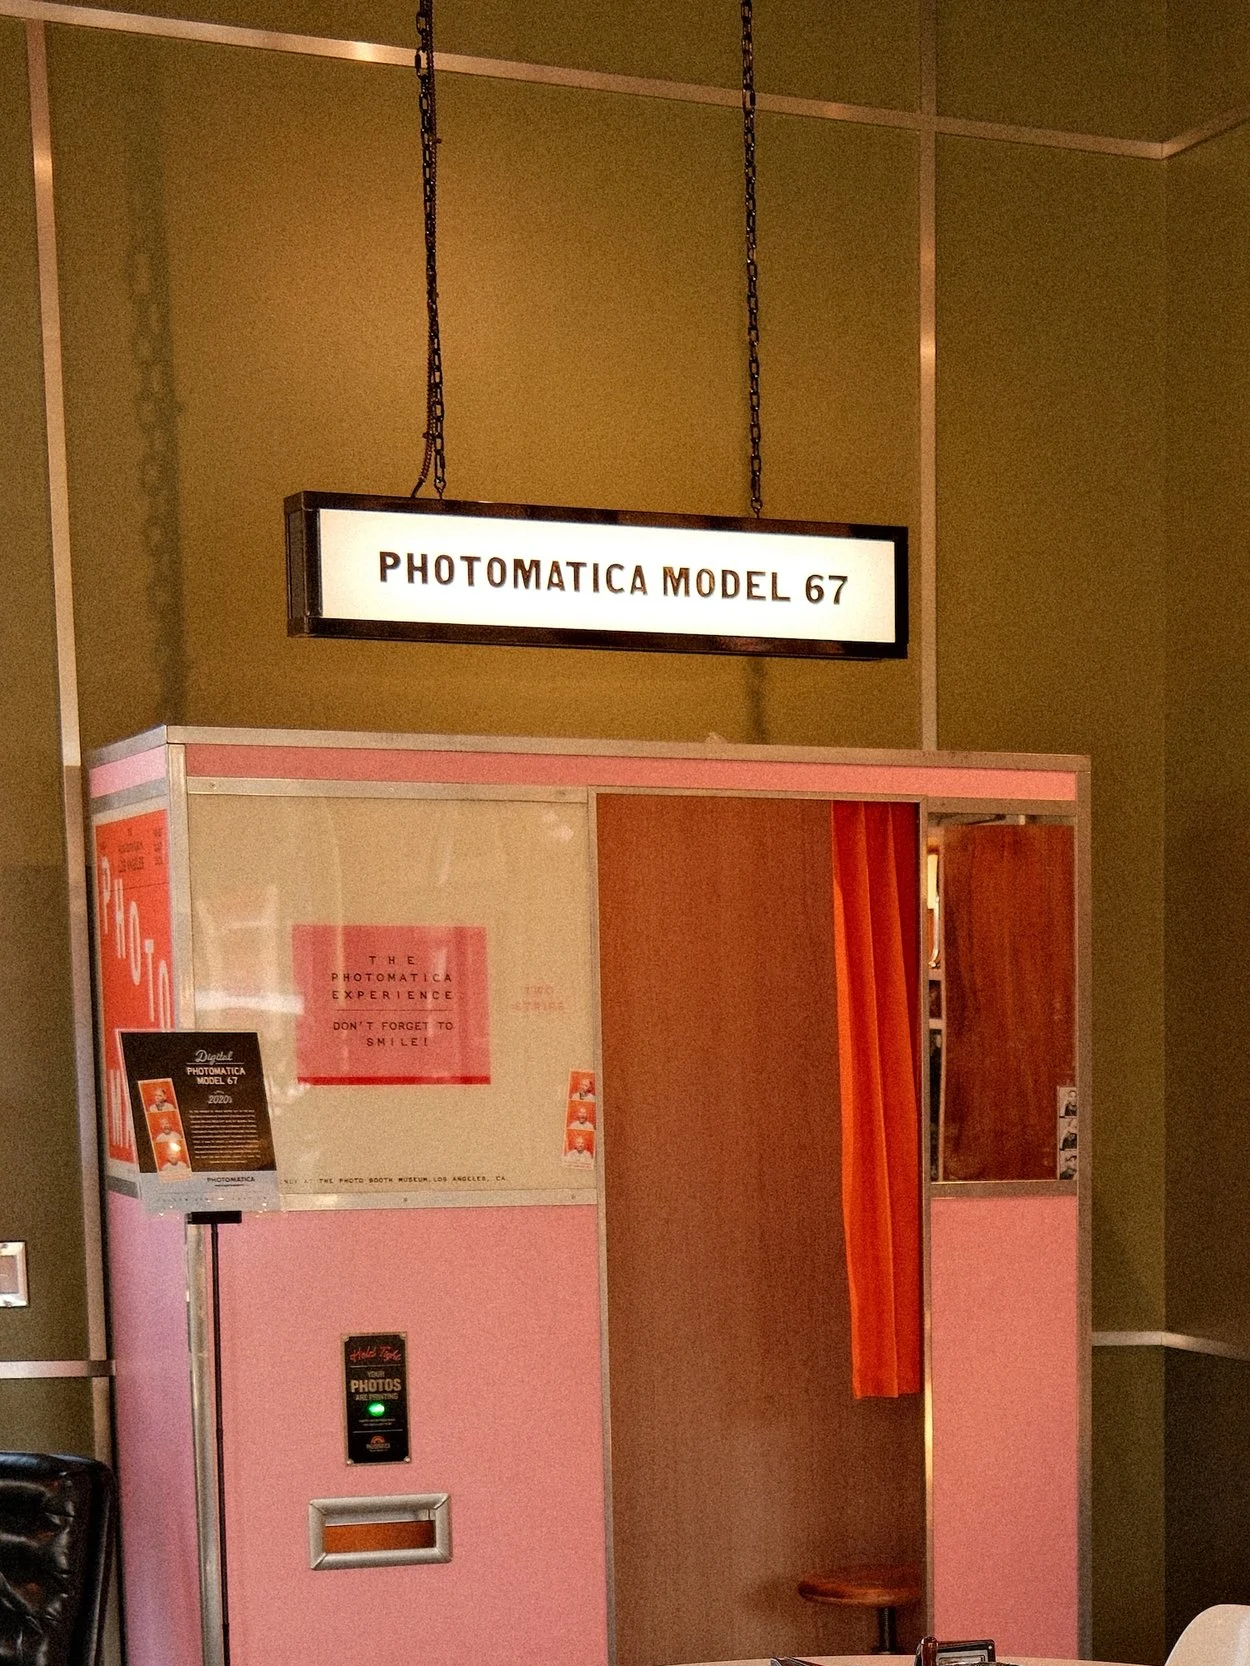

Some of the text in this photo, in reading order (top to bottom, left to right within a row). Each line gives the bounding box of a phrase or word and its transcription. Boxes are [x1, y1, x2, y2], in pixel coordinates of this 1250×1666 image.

[378, 550, 849, 605] PHOTOMATICA MODEL 67
[368, 955, 415, 965] THE
[331, 973, 452, 982] PHOTOMATICA
[332, 991, 453, 1000] EXPERIENCE
[333, 1022, 453, 1031] DON'T FORGET TO
[195, 1050, 233, 1065] Digital
[187, 1067, 246, 1076] PHOTOMATICA
[196, 1076, 238, 1085] MODEL 67
[367, 1371, 385, 1379] YOUR
[350, 1378, 402, 1393] PHOTOS
